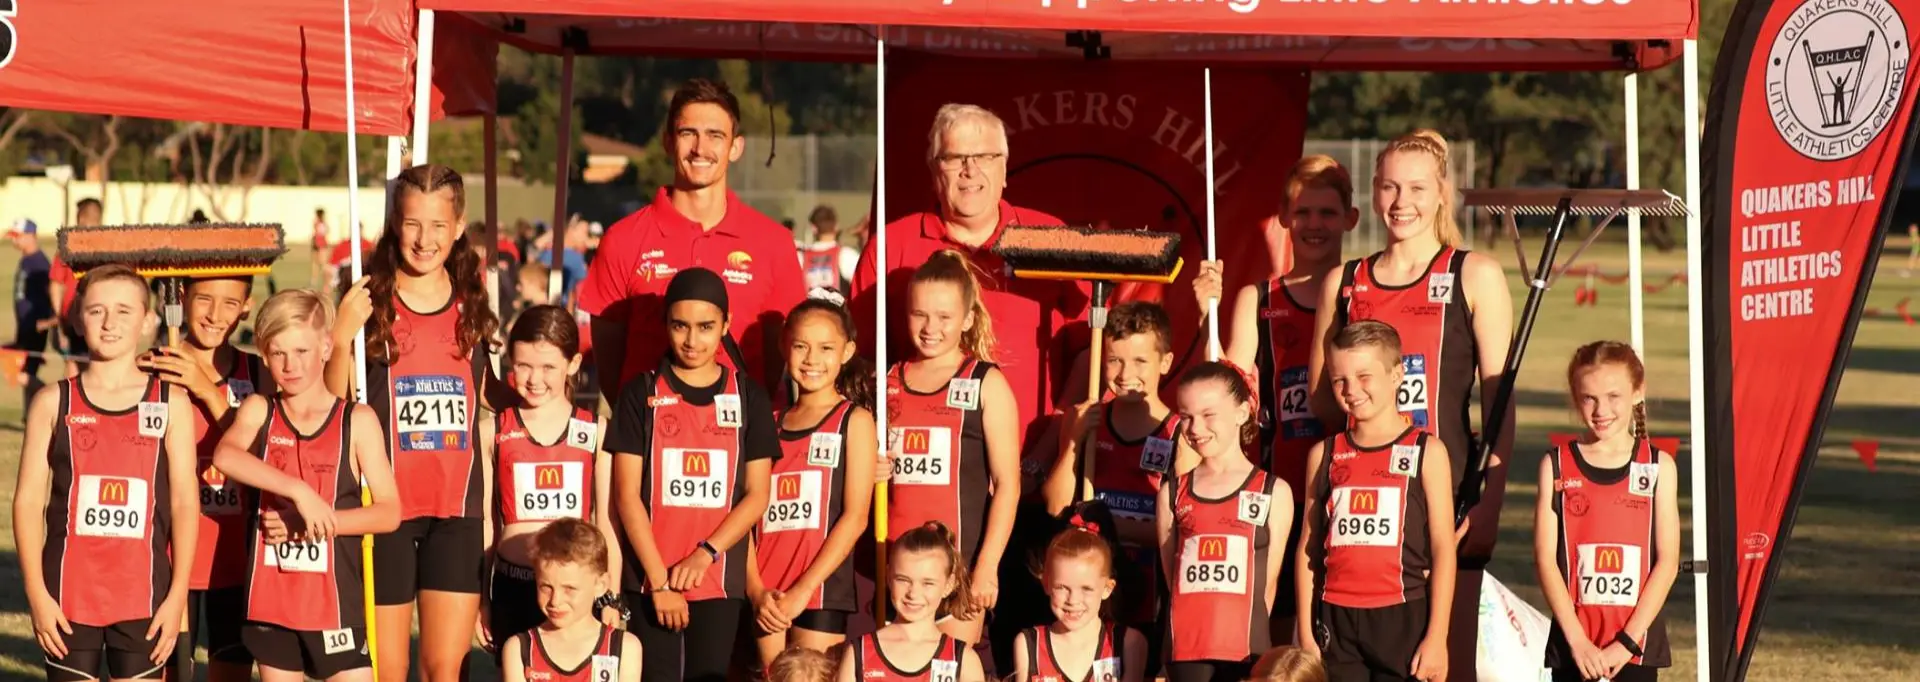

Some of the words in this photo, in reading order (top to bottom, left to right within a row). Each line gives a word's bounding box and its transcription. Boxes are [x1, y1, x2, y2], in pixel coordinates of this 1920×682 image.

[1784, 0, 1859, 42] QUAKERS
[1862, 0, 1893, 30] HILL
[1769, 80, 1798, 139] LITTLE
[1793, 126, 1873, 157] ATHLETICS
[1872, 58, 1907, 130] CENTRE
[1741, 180, 1832, 218] QUAKERS
[1837, 174, 1875, 206] HILL
[1742, 220, 1802, 252] LITTLE
[1741, 250, 1842, 287] ATHLETICS
[1430, 285, 1450, 298] 17
[1741, 288, 1814, 321] CENTRE
[415, 379, 454, 393] ATHLETICS
[954, 391, 970, 403] 11
[1282, 387, 1308, 414] 42
[399, 398, 465, 426] 42115
[722, 409, 738, 423] 11
[145, 416, 163, 430] 10
[577, 431, 589, 444] 9
[814, 447, 831, 460] 11
[1147, 452, 1166, 467] 12
[893, 456, 942, 475] 6845
[1398, 457, 1410, 471] 8
[670, 479, 722, 498] 6916
[1638, 475, 1650, 491] 9
[523, 492, 577, 510] 6919
[85, 507, 139, 529] 6990
[768, 501, 812, 522] 6929
[1248, 503, 1260, 519] 9
[1338, 517, 1391, 536] 6965
[1186, 564, 1239, 583] 6850
[1582, 576, 1633, 596] 7032
[330, 632, 348, 648] 10
[600, 669, 610, 682] 9
